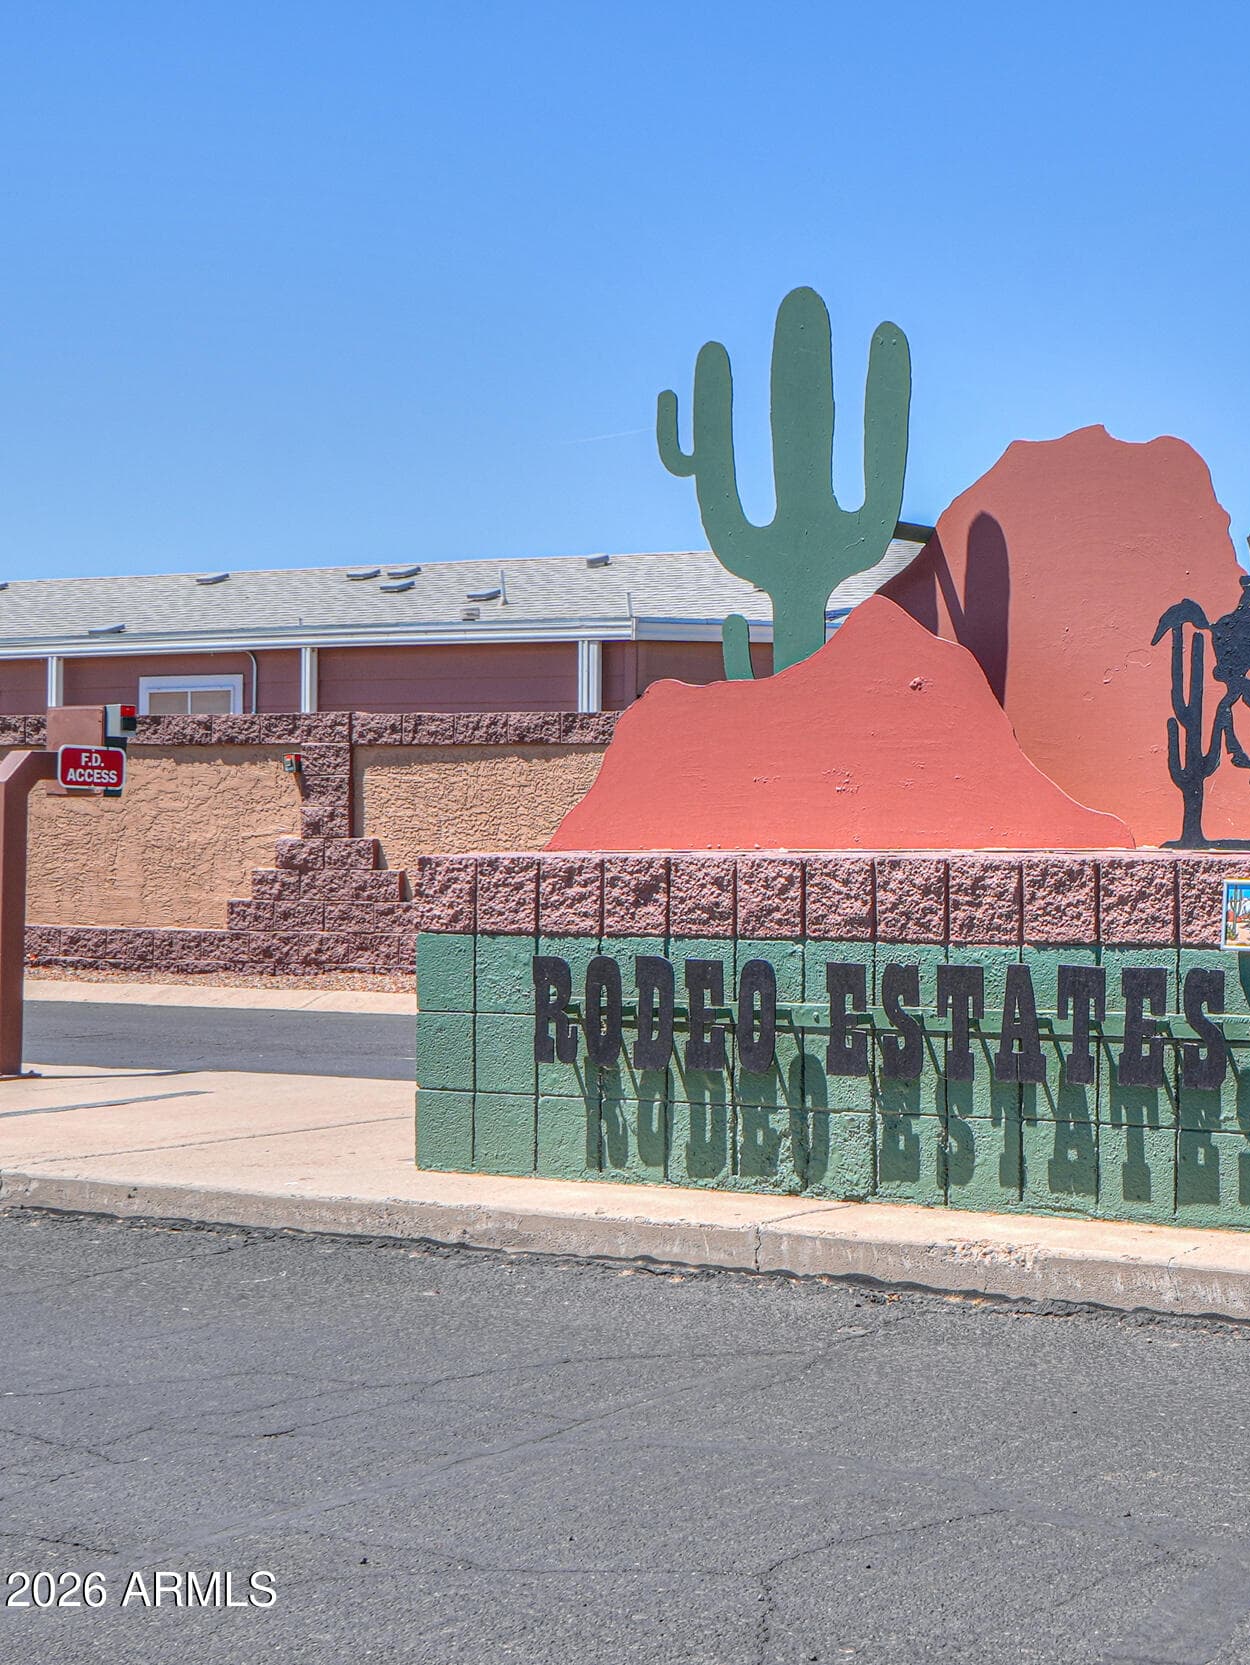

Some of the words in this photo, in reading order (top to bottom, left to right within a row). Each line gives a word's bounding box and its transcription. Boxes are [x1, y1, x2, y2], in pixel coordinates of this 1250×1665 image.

[80, 752, 105, 767] F.D.
[66, 768, 118, 783] ACCESS
[532, 954, 778, 1073] RODEO
[825, 961, 1228, 1090] ESTATES
